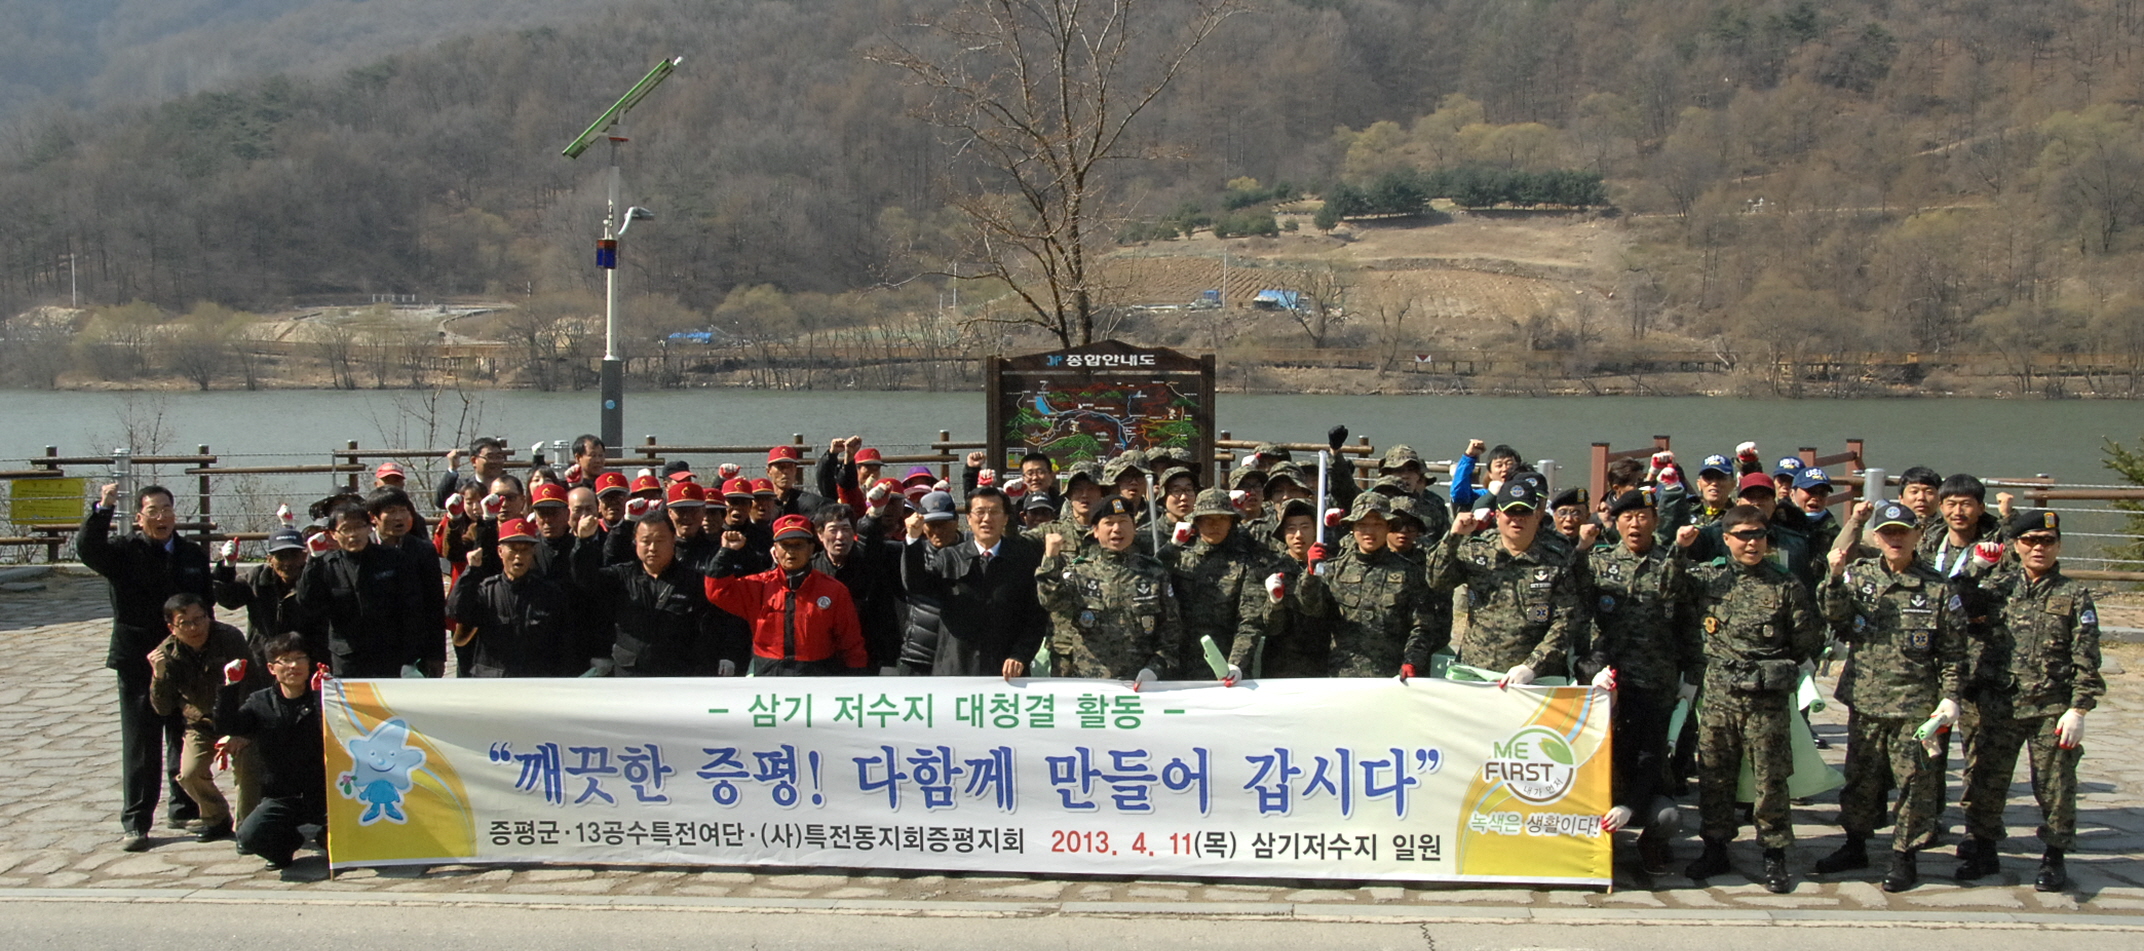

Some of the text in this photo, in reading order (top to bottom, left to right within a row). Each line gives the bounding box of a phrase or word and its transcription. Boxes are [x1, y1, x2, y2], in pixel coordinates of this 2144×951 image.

[1066, 354, 1156, 367] 종합안내도
[748, 694, 812, 728] 삼기
[834, 693, 933, 728] 저수지
[956, 693, 1055, 729] 대청결
[1076, 693, 1145, 730] 활동
[1493, 741, 1529, 760] ME
[489, 742, 1440, 816] “깨끗한 증평! 다함께 만들어 갑시다”
[1485, 762, 1554, 782] FIRST
[1523, 778, 1564, 797] 내가 먼저
[1471, 814, 1600, 835] 녹색은 생활이다!
[1051, 830, 1118, 857] 2013.
[1132, 832, 1155, 857] 4.
[1170, 830, 1237, 861] 11(목)
[1251, 832, 1377, 862] 삼기저수지
[1392, 834, 1441, 863] 일원
